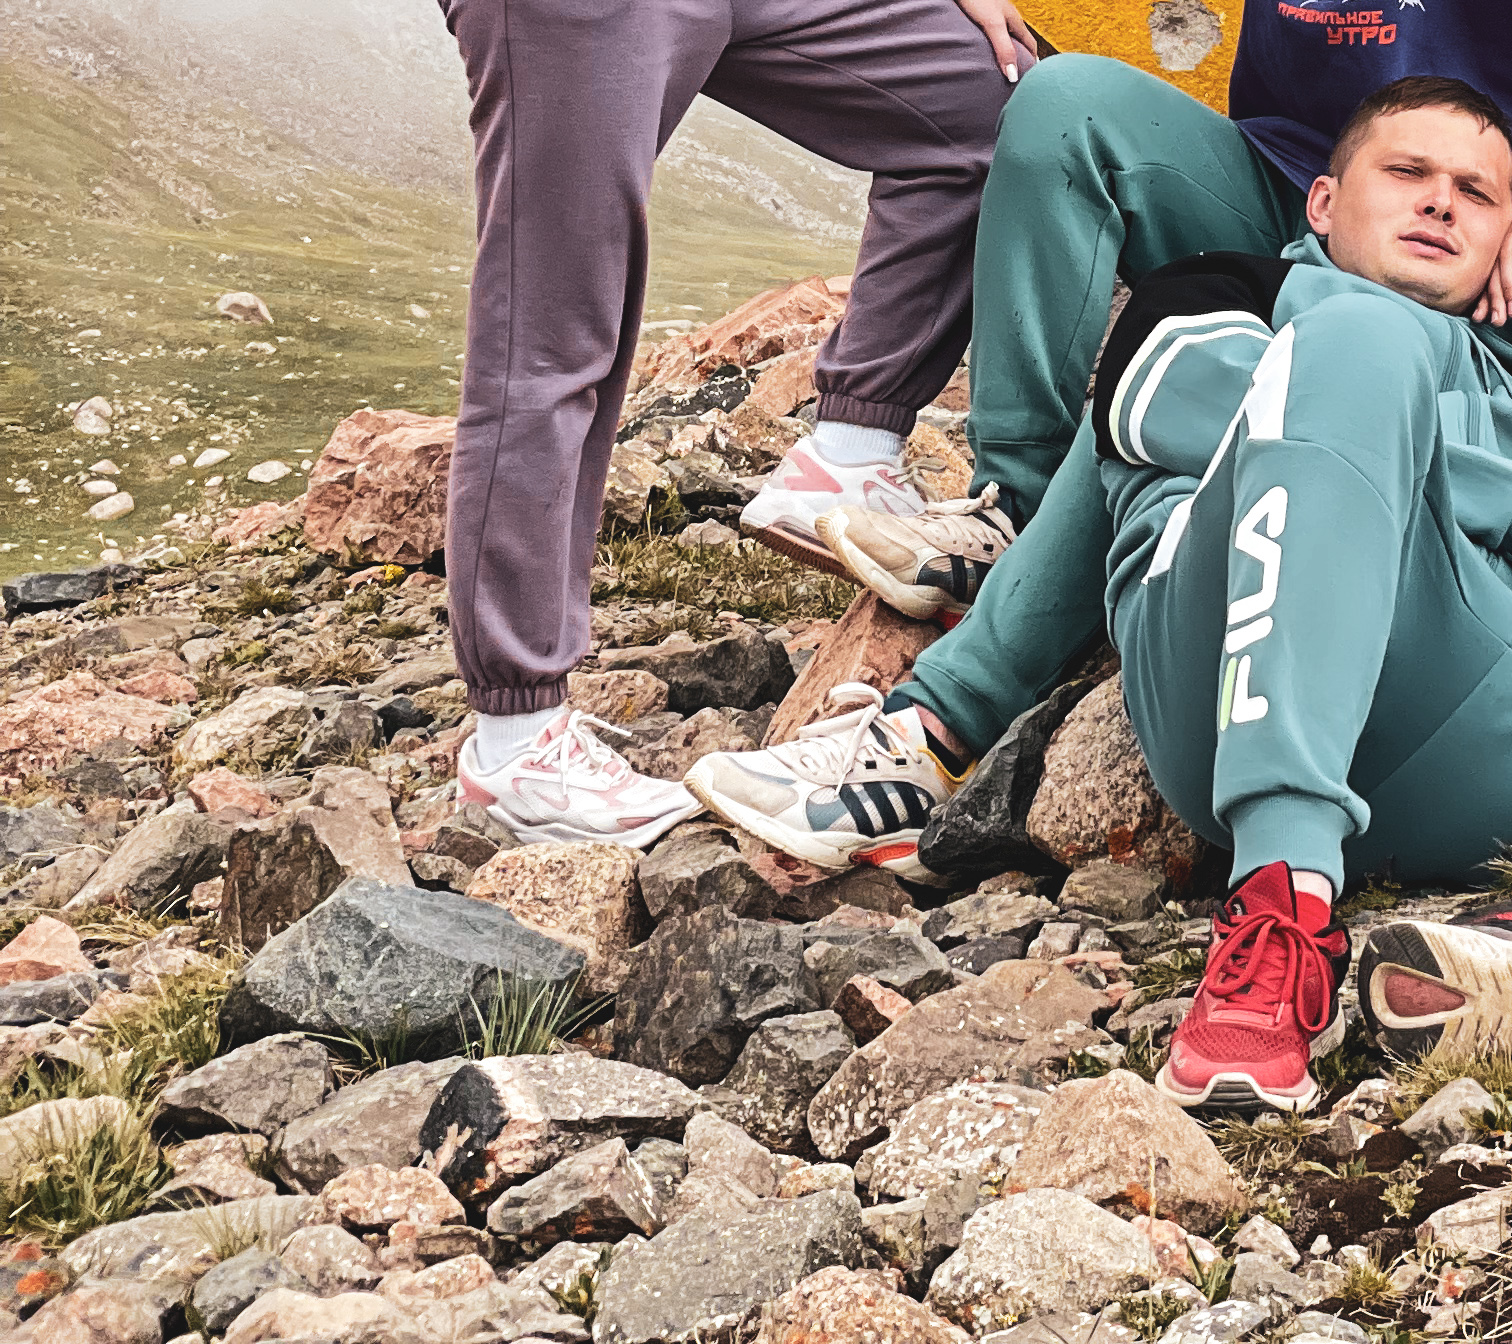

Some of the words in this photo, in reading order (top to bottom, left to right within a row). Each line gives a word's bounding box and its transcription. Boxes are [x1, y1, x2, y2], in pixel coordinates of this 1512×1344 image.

[1277, 1, 1384, 25] ПРАВИЛЬНОЕ
[1326, 23, 1398, 47] УТРО
[1219, 485, 1289, 732] FILA
